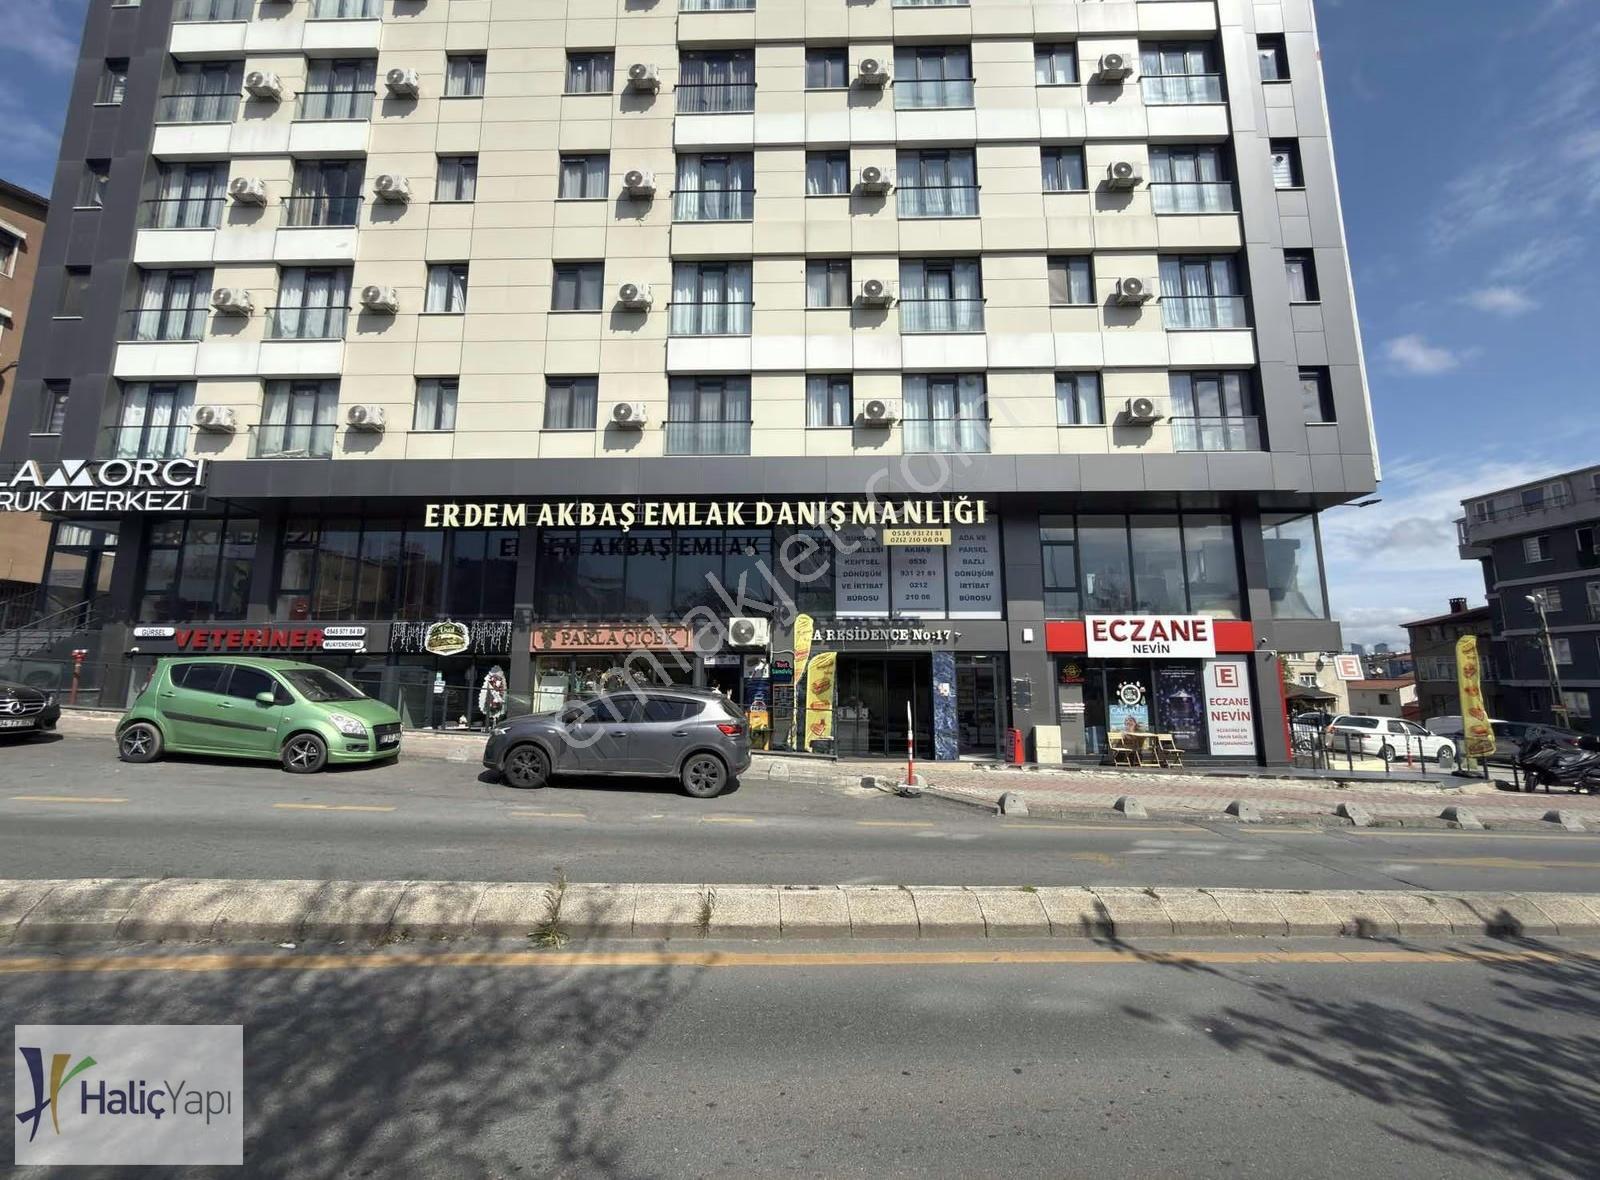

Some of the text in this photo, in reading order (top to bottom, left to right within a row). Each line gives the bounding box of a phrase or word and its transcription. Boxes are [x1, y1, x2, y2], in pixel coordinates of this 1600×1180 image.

[424, 496, 986, 532] ERDEM AKBAŞ EMLAK DANIŞMANLIĞI
[842, 569, 882, 578] DÖNÜŞÜM
[954, 569, 994, 578] DÖNÜŞÜM
[959, 581, 990, 589] İRTİBAT
[846, 593, 879, 602] BÜROSU
[959, 593, 992, 602] BÜROSU
[913, 629, 952, 641] No:17
[1093, 619, 1208, 642] ECZANE
[176, 626, 324, 649] VETERİNER
[561, 627, 678, 648] PARLA ÇİÇEK
[1132, 641, 1171, 654] NEVİN
[1342, 660, 1359, 675] E
[1220, 668, 1234, 684] E
[1209, 697, 1249, 706] ECZANE
[1211, 708, 1251, 721] NEVİN
